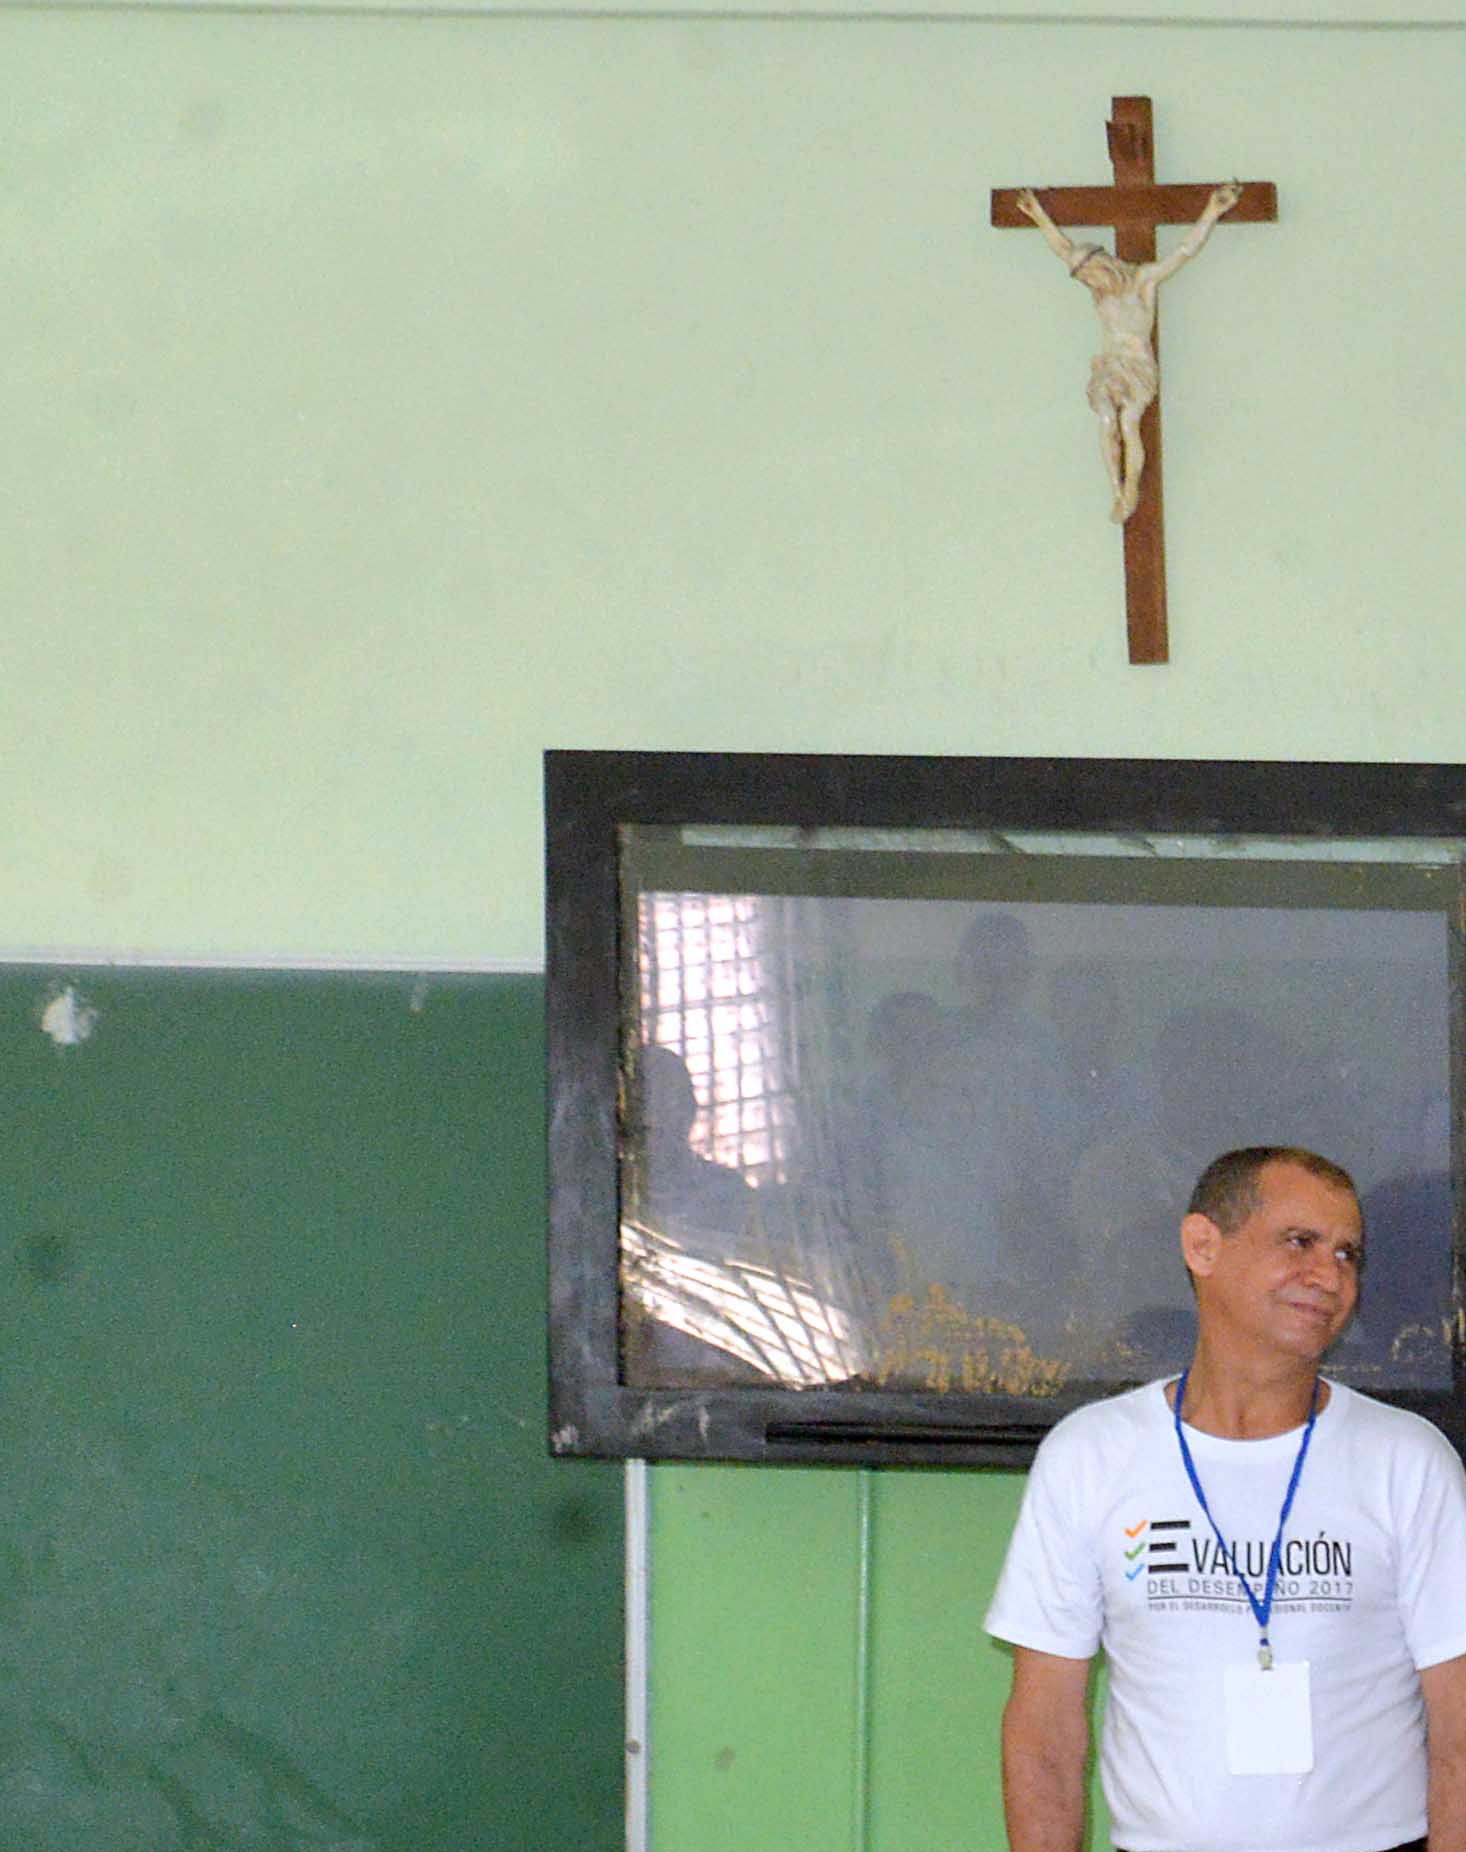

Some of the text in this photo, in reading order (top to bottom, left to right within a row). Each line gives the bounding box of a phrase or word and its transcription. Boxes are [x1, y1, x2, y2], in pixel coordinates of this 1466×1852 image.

[1147, 1578, 1353, 1597] DEL DESEMPÑO 2017
